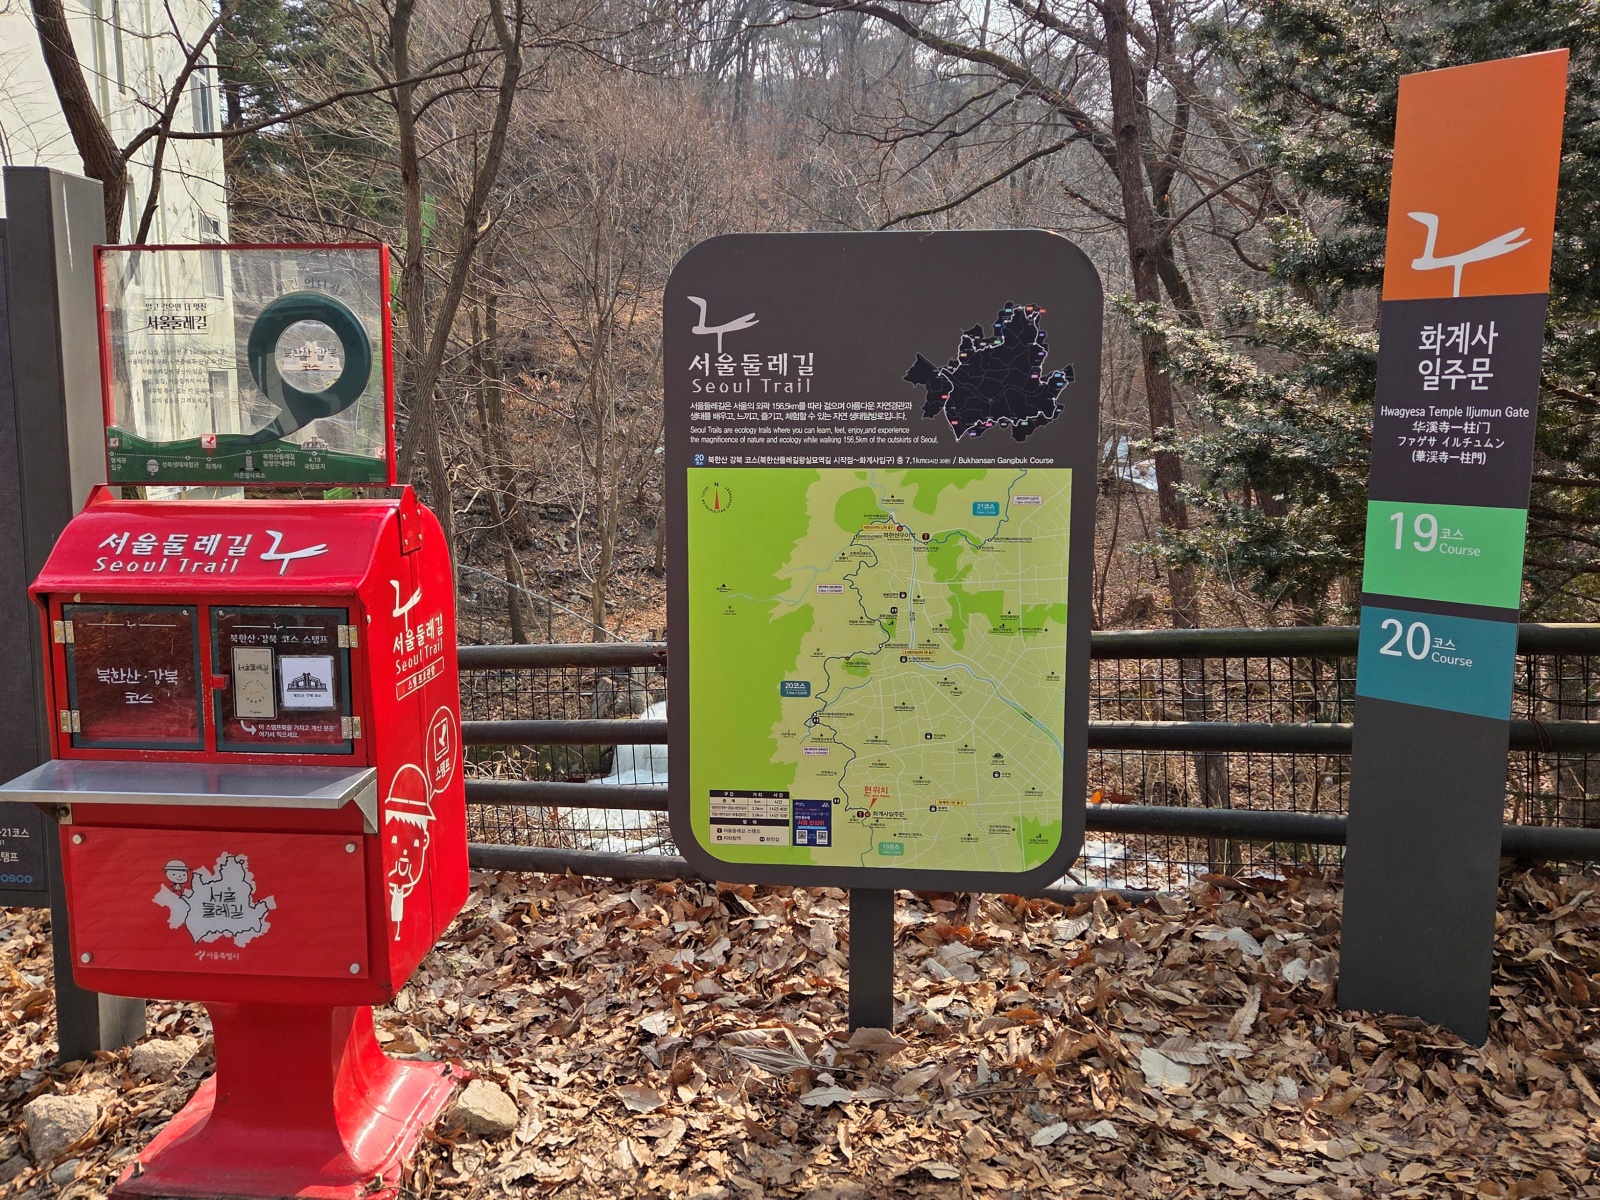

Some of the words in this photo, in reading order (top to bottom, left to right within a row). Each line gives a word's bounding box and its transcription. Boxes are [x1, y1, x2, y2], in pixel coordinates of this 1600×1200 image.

[145, 302, 159, 311] 알고
[184, 302, 191, 311] 더
[193, 302, 207, 311] 멋진
[146, 315, 207, 330] 서울둘레길
[1418, 320, 1499, 356] 화계사
[688, 352, 814, 377] 서울둘레길
[1418, 357, 1494, 391] 일주문
[692, 378, 751, 393] Seoul
[760, 378, 811, 394] Trail
[690, 402, 732, 410] 서울둘레길은
[733, 402, 755, 410] 서울의
[807, 402, 823, 410] 따라
[824, 402, 845, 410] 걸으며
[846, 402, 876, 410] 아름다운
[876, 402, 913, 410] 자연경관과
[1380, 405, 1426, 419] Hwagyesa
[1429, 405, 1463, 419] Temple
[1466, 405, 1502, 420] Iljumun
[1505, 406, 1530, 418] Gate
[690, 412, 712, 421] 생태를
[808, 412, 816, 421] 수
[817, 412, 832, 421] 있는
[832, 412, 848, 421] 자연
[690, 426, 706, 434] Seoul
[708, 426, 722, 434] Trails
[724, 426, 733, 434] are
[734, 426, 757, 434] ecology
[758, 426, 772, 434] trails
[773, 426, 790, 434] where
[792, 426, 803, 434] you
[804, 426, 816, 434] can
[816, 426, 833, 434] learn,
[834, 426, 846, 434] feel,
[878, 426, 910, 434] experience
[690, 436, 700, 444] the
[701, 436, 738, 444] magnificence
[740, 436, 746, 444] of
[746, 436, 765, 444] nature
[766, 436, 778, 444] and
[778, 436, 802, 444] ecology
[803, 436, 819, 444] while
[820, 436, 842, 444] walking
[869, 436, 876, 444] of
[876, 436, 886, 444] the
[887, 436, 912, 444] outskirts
[912, 436, 920, 444] of
[1397, 435, 1437, 447] ファゲサ
[1442, 436, 1505, 449] イルチュムン
[708, 456, 728, 465] 북한산
[730, 456, 743, 465] 강북
[896, 456, 904, 465] 총
[958, 456, 996, 465] Bukhansan
[997, 456, 1028, 465] Gangbuk
[1029, 456, 1054, 465] Course
[1390, 511, 1439, 553] 19
[1440, 528, 1464, 541] 코스
[98, 530, 253, 556] 서울둘레길
[1439, 543, 1481, 557] Course
[92, 556, 168, 573] Seoul
[178, 558, 239, 574] Trail
[230, 633, 278, 644] 북한산·강북
[281, 634, 300, 644] 코스
[302, 634, 328, 645] 스탬프
[392, 613, 444, 656] 서울둘레길
[1379, 618, 1431, 660] 20
[1432, 637, 1456, 651] 코스
[395, 648, 423, 675] Seoul
[424, 637, 443, 659] Trail
[1431, 651, 1473, 668] Course
[96, 668, 179, 685] 북한산·강북
[125, 692, 154, 704] 코스
[435, 757, 451, 782] 스탬프
[864, 785, 889, 794] 현위치
[0, 851, 19, 863] 탬프
[210, 886, 236, 903] 서울
[202, 902, 244, 920] 둘레길
[206, 951, 240, 960] 서울특별시
